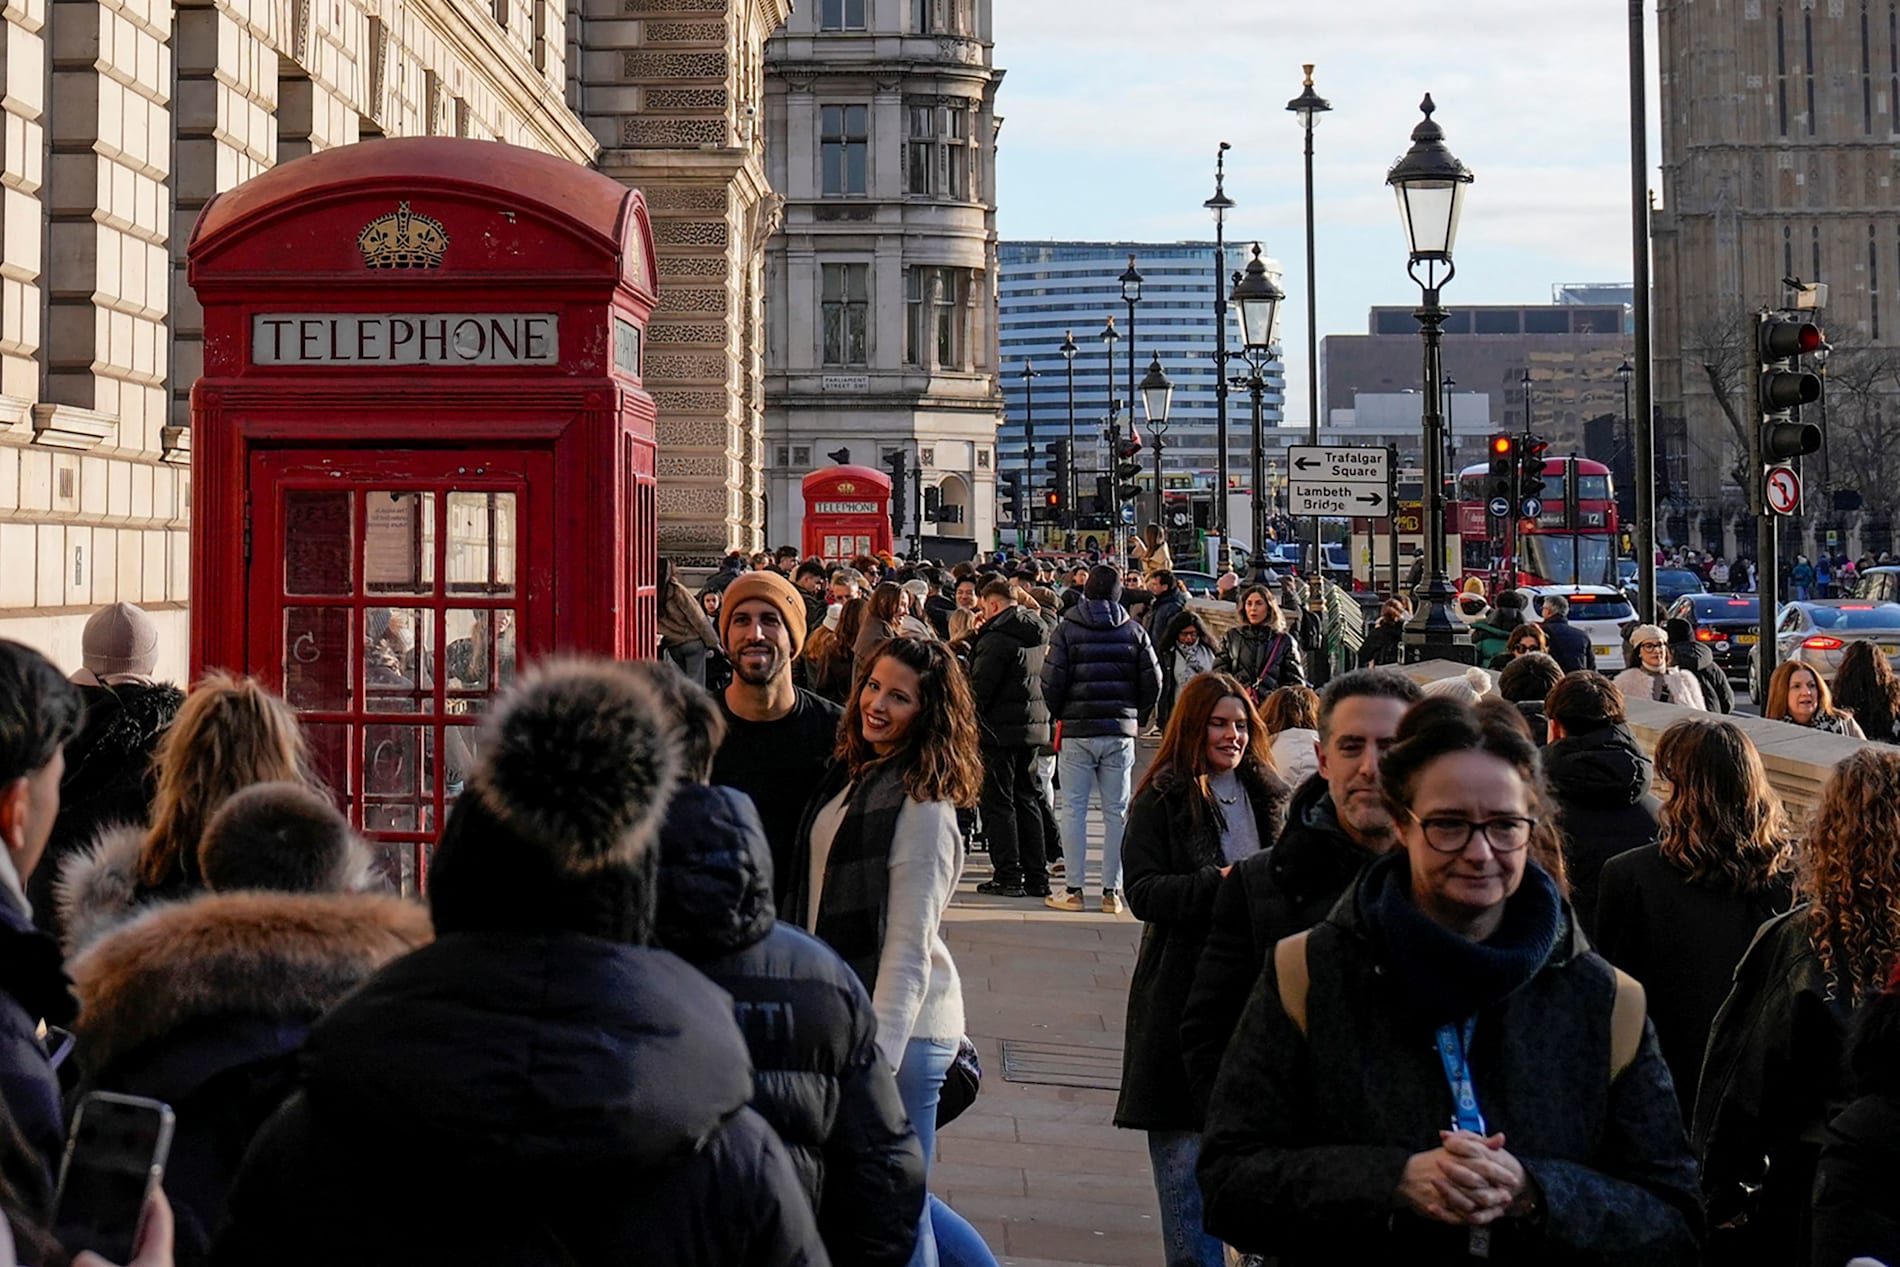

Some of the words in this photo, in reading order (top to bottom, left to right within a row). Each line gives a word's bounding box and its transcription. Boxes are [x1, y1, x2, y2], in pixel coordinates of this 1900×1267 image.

[262, 319, 549, 360] TELEPHONE
[1325, 452, 1383, 465] Trafalgar
[1332, 465, 1377, 477] Square
[1296, 486, 1352, 497] Lambeth
[817, 502, 877, 513] TELEPHONE
[1304, 499, 1345, 512] Bridge
[1588, 513, 1599, 525] 12
